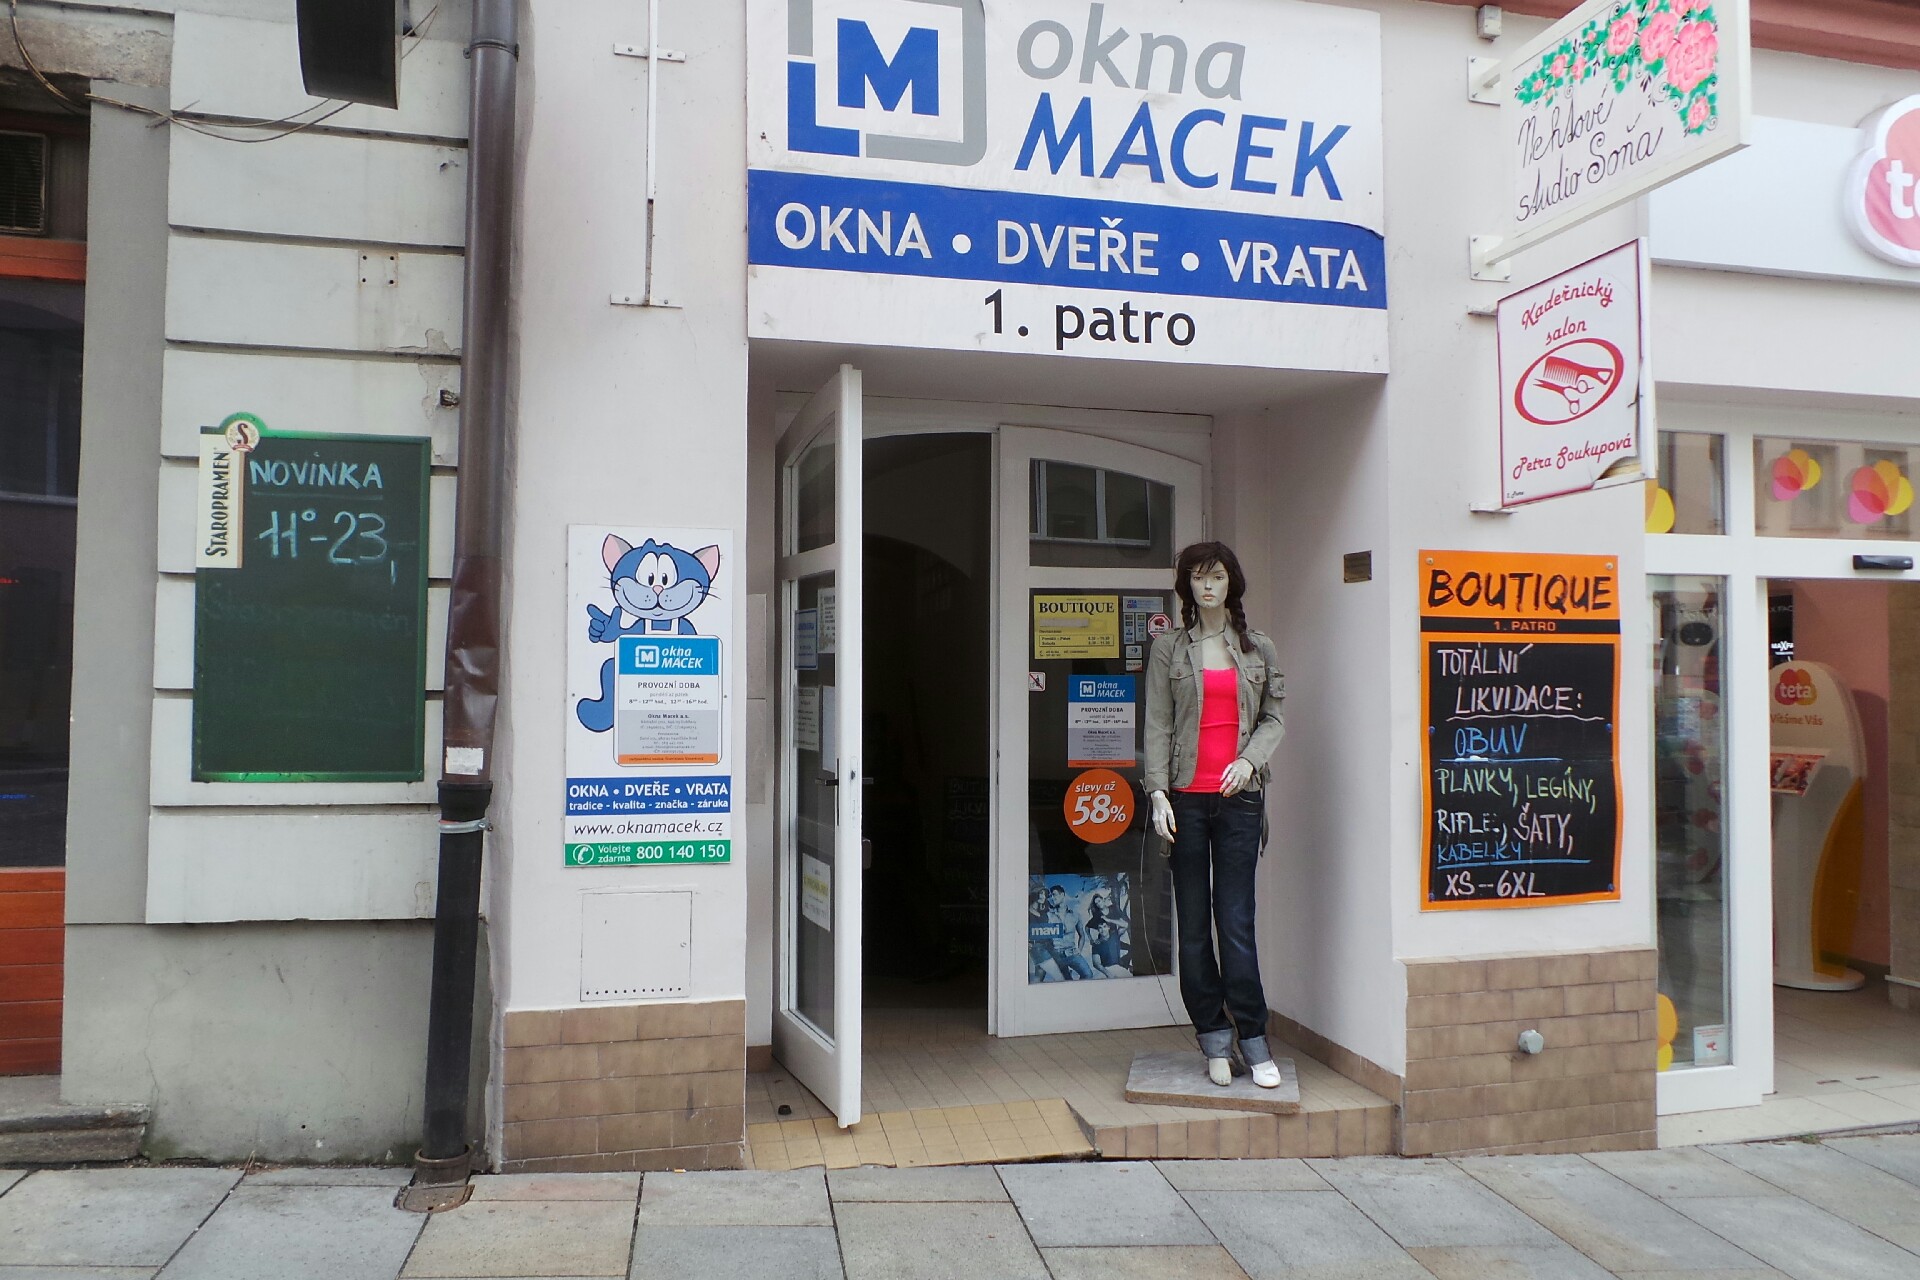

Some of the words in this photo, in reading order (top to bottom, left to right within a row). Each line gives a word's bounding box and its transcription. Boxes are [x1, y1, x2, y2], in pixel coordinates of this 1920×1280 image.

[1017, 3, 1246, 100] okna
[1014, 92, 1351, 201] MACEK
[1587, 112, 1663, 183] Soňa
[775, 201, 932, 259] OKNA
[997, 217, 1159, 275] DVEŘE
[1220, 239, 1367, 291] VRATA
[1521, 277, 1613, 330] Kadeřnický
[984, 288, 1029, 337] 1.
[1055, 299, 1196, 351] patro
[1545, 316, 1587, 346] salon
[1513, 456, 1552, 480] Petra
[1557, 433, 1632, 470] Soukupová
[250, 456, 383, 489] NOVINKA
[205, 451, 230, 557] STAROPRAMEN
[1427, 569, 1612, 615] BOUTIQUE
[1039, 602, 1114, 615] BOUTIQUE
[1493, 621, 1507, 631] 1.
[1511, 621, 1556, 632] PATRO
[661, 645, 692, 657] okna
[661, 657, 704, 669] MACEK
[1437, 642, 1534, 676] TOTÁLNÍ
[637, 680, 677, 689] PROVOZNÍ
[1097, 681, 1118, 689] okna
[1097, 689, 1126, 698] MACEK
[1455, 684, 1582, 714] LIKVIDACE:
[1780, 683, 1811, 698] teta
[1455, 723, 1528, 757] OBUV
[569, 785, 609, 798] OKNA
[625, 781, 670, 796] DVEŘE
[686, 783, 729, 796] VRATA
[1075, 782, 1102, 793] slevy
[1104, 781, 1116, 791] až
[1434, 767, 1518, 807] PLAVKY,
[1526, 766, 1595, 814] LEGÍNY,
[569, 801, 603, 811] tradice
[613, 800, 646, 810] kvalita
[655, 799, 688, 809] značka
[697, 799, 729, 808] záruka
[1072, 794, 1126, 826] 58%
[574, 820, 723, 835] www.oknamacek.cz
[1513, 802, 1573, 855] ŠATY,
[598, 845, 631, 854] Volejte
[636, 846, 663, 859] 800
[669, 846, 694, 858] 140
[700, 844, 725, 858] 150
[598, 854, 631, 864] zdarma
[1437, 841, 1522, 863] KABELKY
[1031, 924, 1060, 936] mavi
